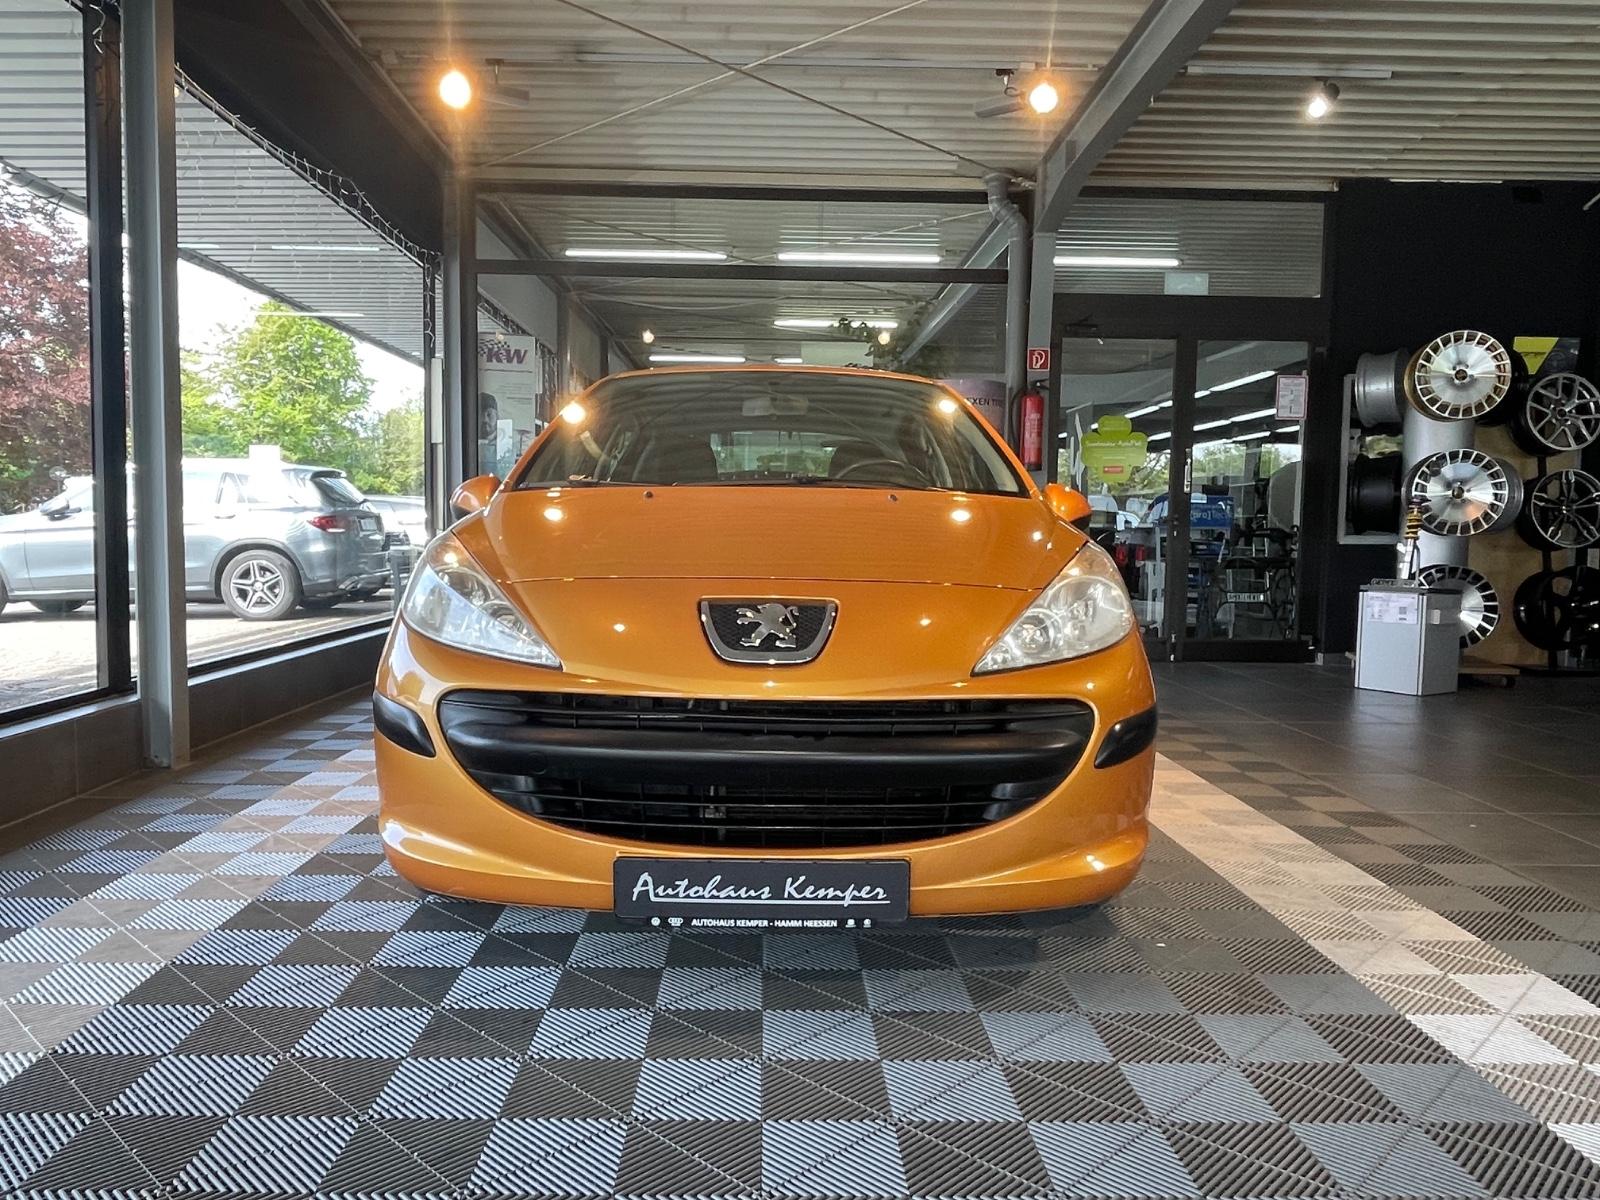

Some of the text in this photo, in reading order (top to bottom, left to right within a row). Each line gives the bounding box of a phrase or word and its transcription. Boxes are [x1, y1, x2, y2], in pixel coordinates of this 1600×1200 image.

[486, 347, 528, 364] KW
[632, 872, 887, 907] Autohaus Kemper
[691, 918, 735, 927] AUTOHAUS
[736, 919, 769, 927] KEMPER
[774, 919, 803, 928] HAMM
[803, 919, 838, 928] HEESSEN
